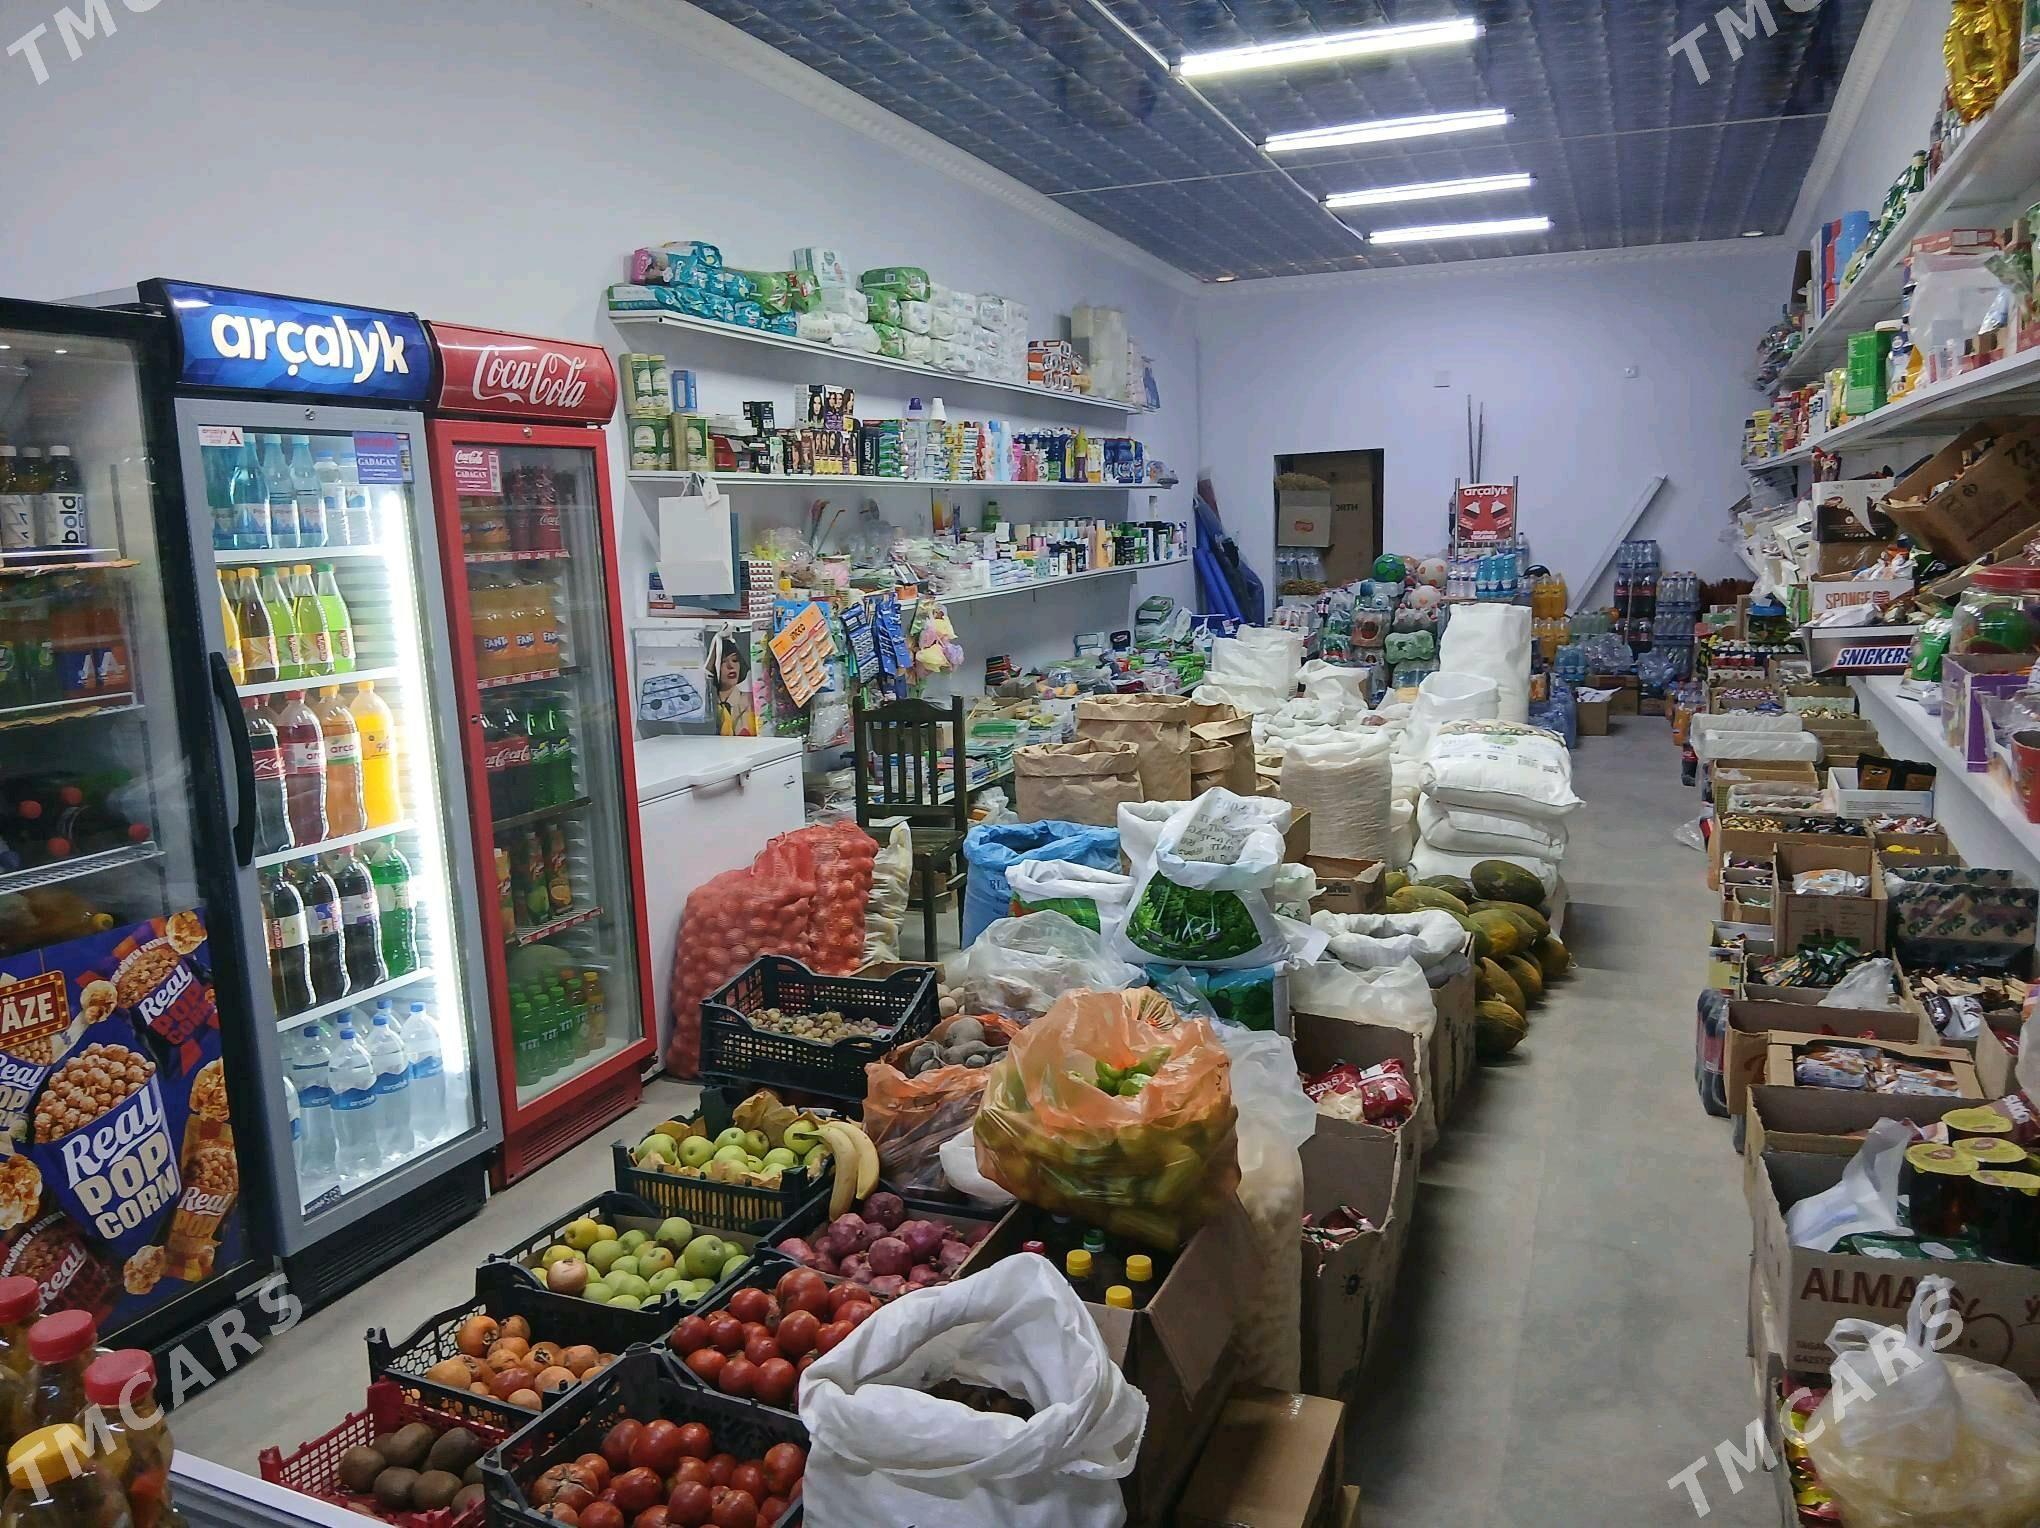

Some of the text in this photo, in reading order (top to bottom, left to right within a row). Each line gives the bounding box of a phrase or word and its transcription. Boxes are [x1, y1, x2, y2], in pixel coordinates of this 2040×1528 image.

[211, 312, 410, 383] arçalyk
[228, 430, 241, 445] A
[59, 495, 80, 544] bold
[1463, 487, 1508, 498] arçalyk
[1837, 648, 1911, 665] SNICKERS
[139, 964, 191, 1026] Real
[61, 1085, 162, 1188] Real
[73, 1131, 170, 1216] POP
[96, 1164, 179, 1240] CORN
[178, 1186, 234, 1213] Real
[36, 1243, 86, 1311] Real
